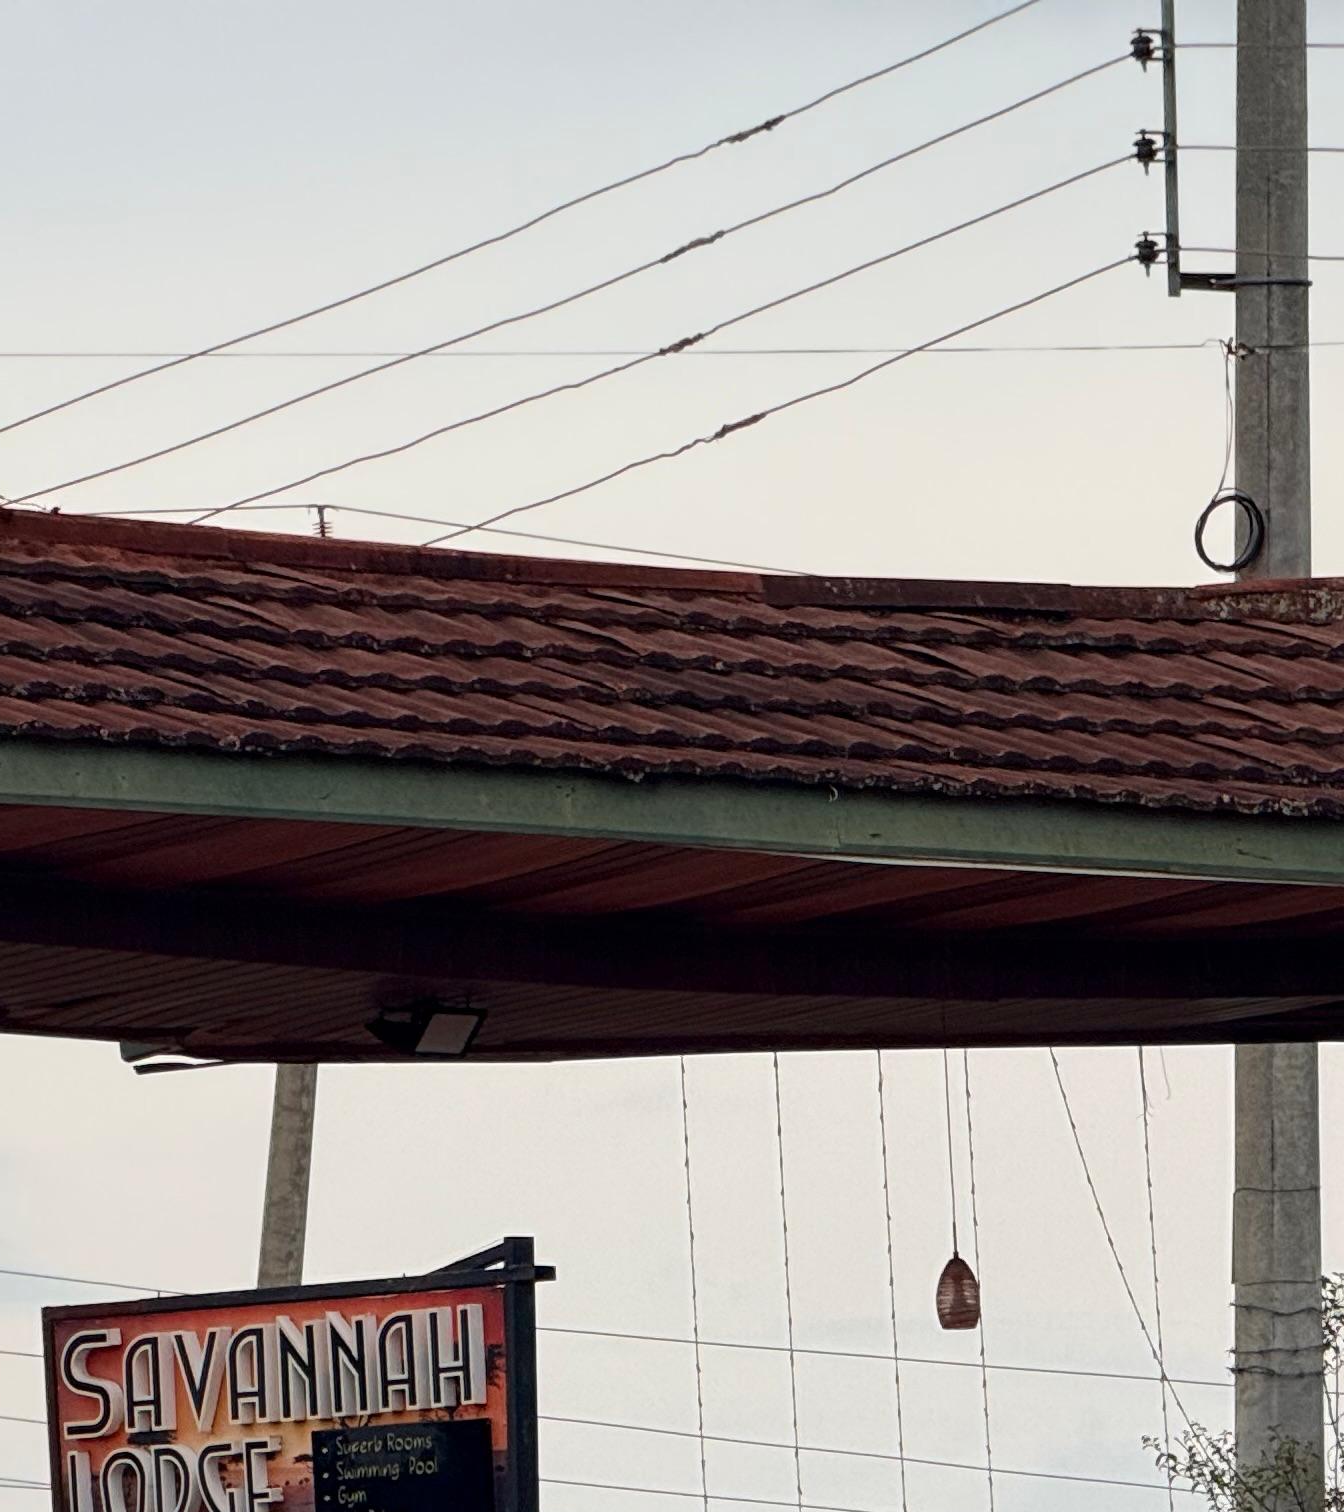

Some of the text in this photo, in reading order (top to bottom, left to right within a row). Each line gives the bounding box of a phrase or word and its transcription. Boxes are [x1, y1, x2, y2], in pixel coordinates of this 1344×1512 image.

[60, 1303, 487, 1440] SAVANNAH
[336, 1432, 432, 1459] Superb Rooms
[336, 1456, 439, 1481] Swimming Pool
[337, 1485, 367, 1508] Gym
